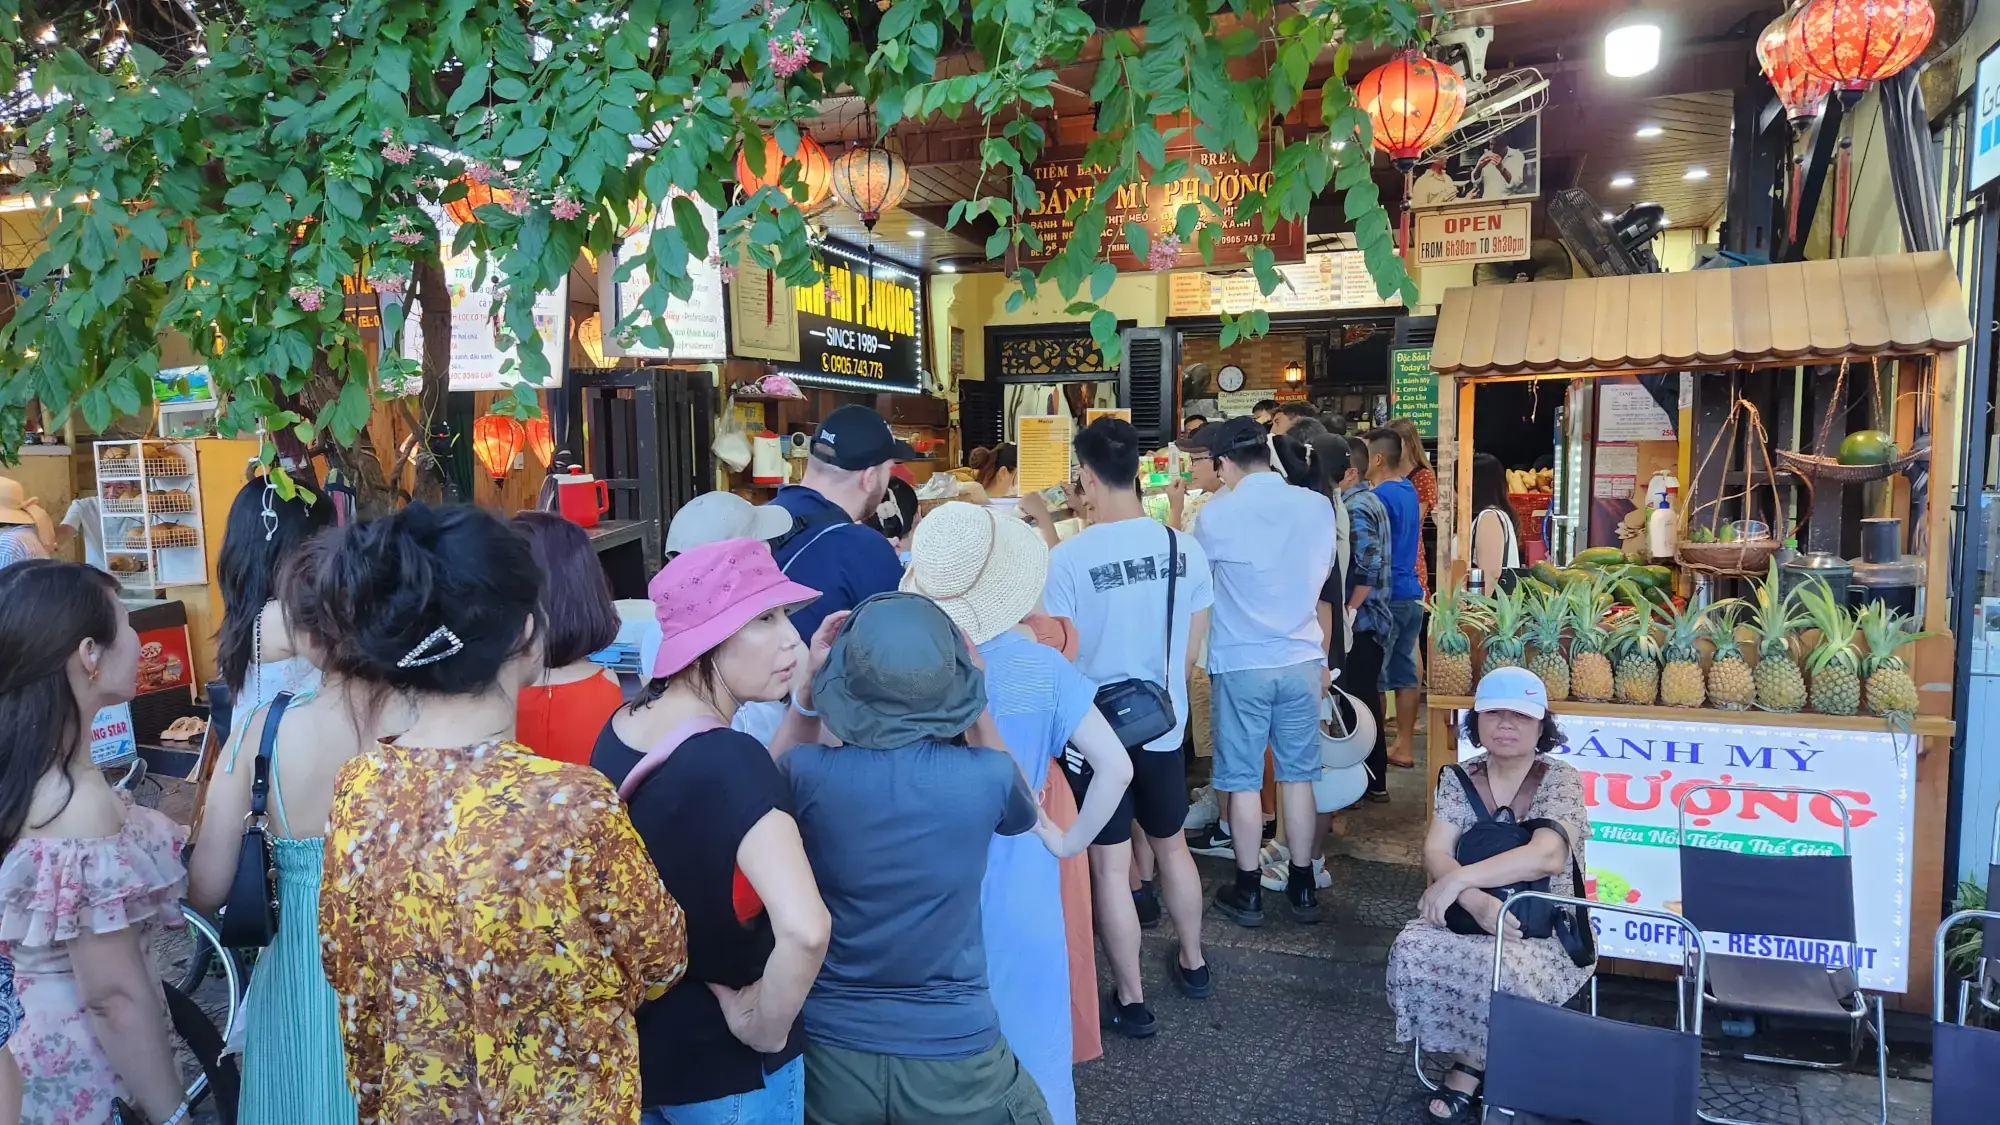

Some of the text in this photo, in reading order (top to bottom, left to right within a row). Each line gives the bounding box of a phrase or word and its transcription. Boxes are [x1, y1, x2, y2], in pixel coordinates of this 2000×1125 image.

[1034, 163, 1069, 180] TIỆM
[1445, 215, 1501, 233] OPEN
[1037, 230, 1057, 241] ÁNH
[1221, 236, 1241, 245] 0905
[1244, 234, 1258, 242] 743
[1261, 233, 1276, 241] 773
[1421, 236, 1524, 258] FROM 6h30am TO 9h30pm
[830, 261, 852, 322] MÌ
[856, 273, 915, 341] PHƯỢNG
[826, 326, 878, 353] SINCE 1989
[830, 354, 884, 380] 0905.743.773
[1400, 363, 1426, 372] Today's
[107, 721, 128, 737] STAR
[1725, 741, 1824, 772] MỲ
[1600, 825, 1644, 842] Hiệu
[1748, 838, 1787, 854] Thế
[1625, 920, 1698, 948] COFF
